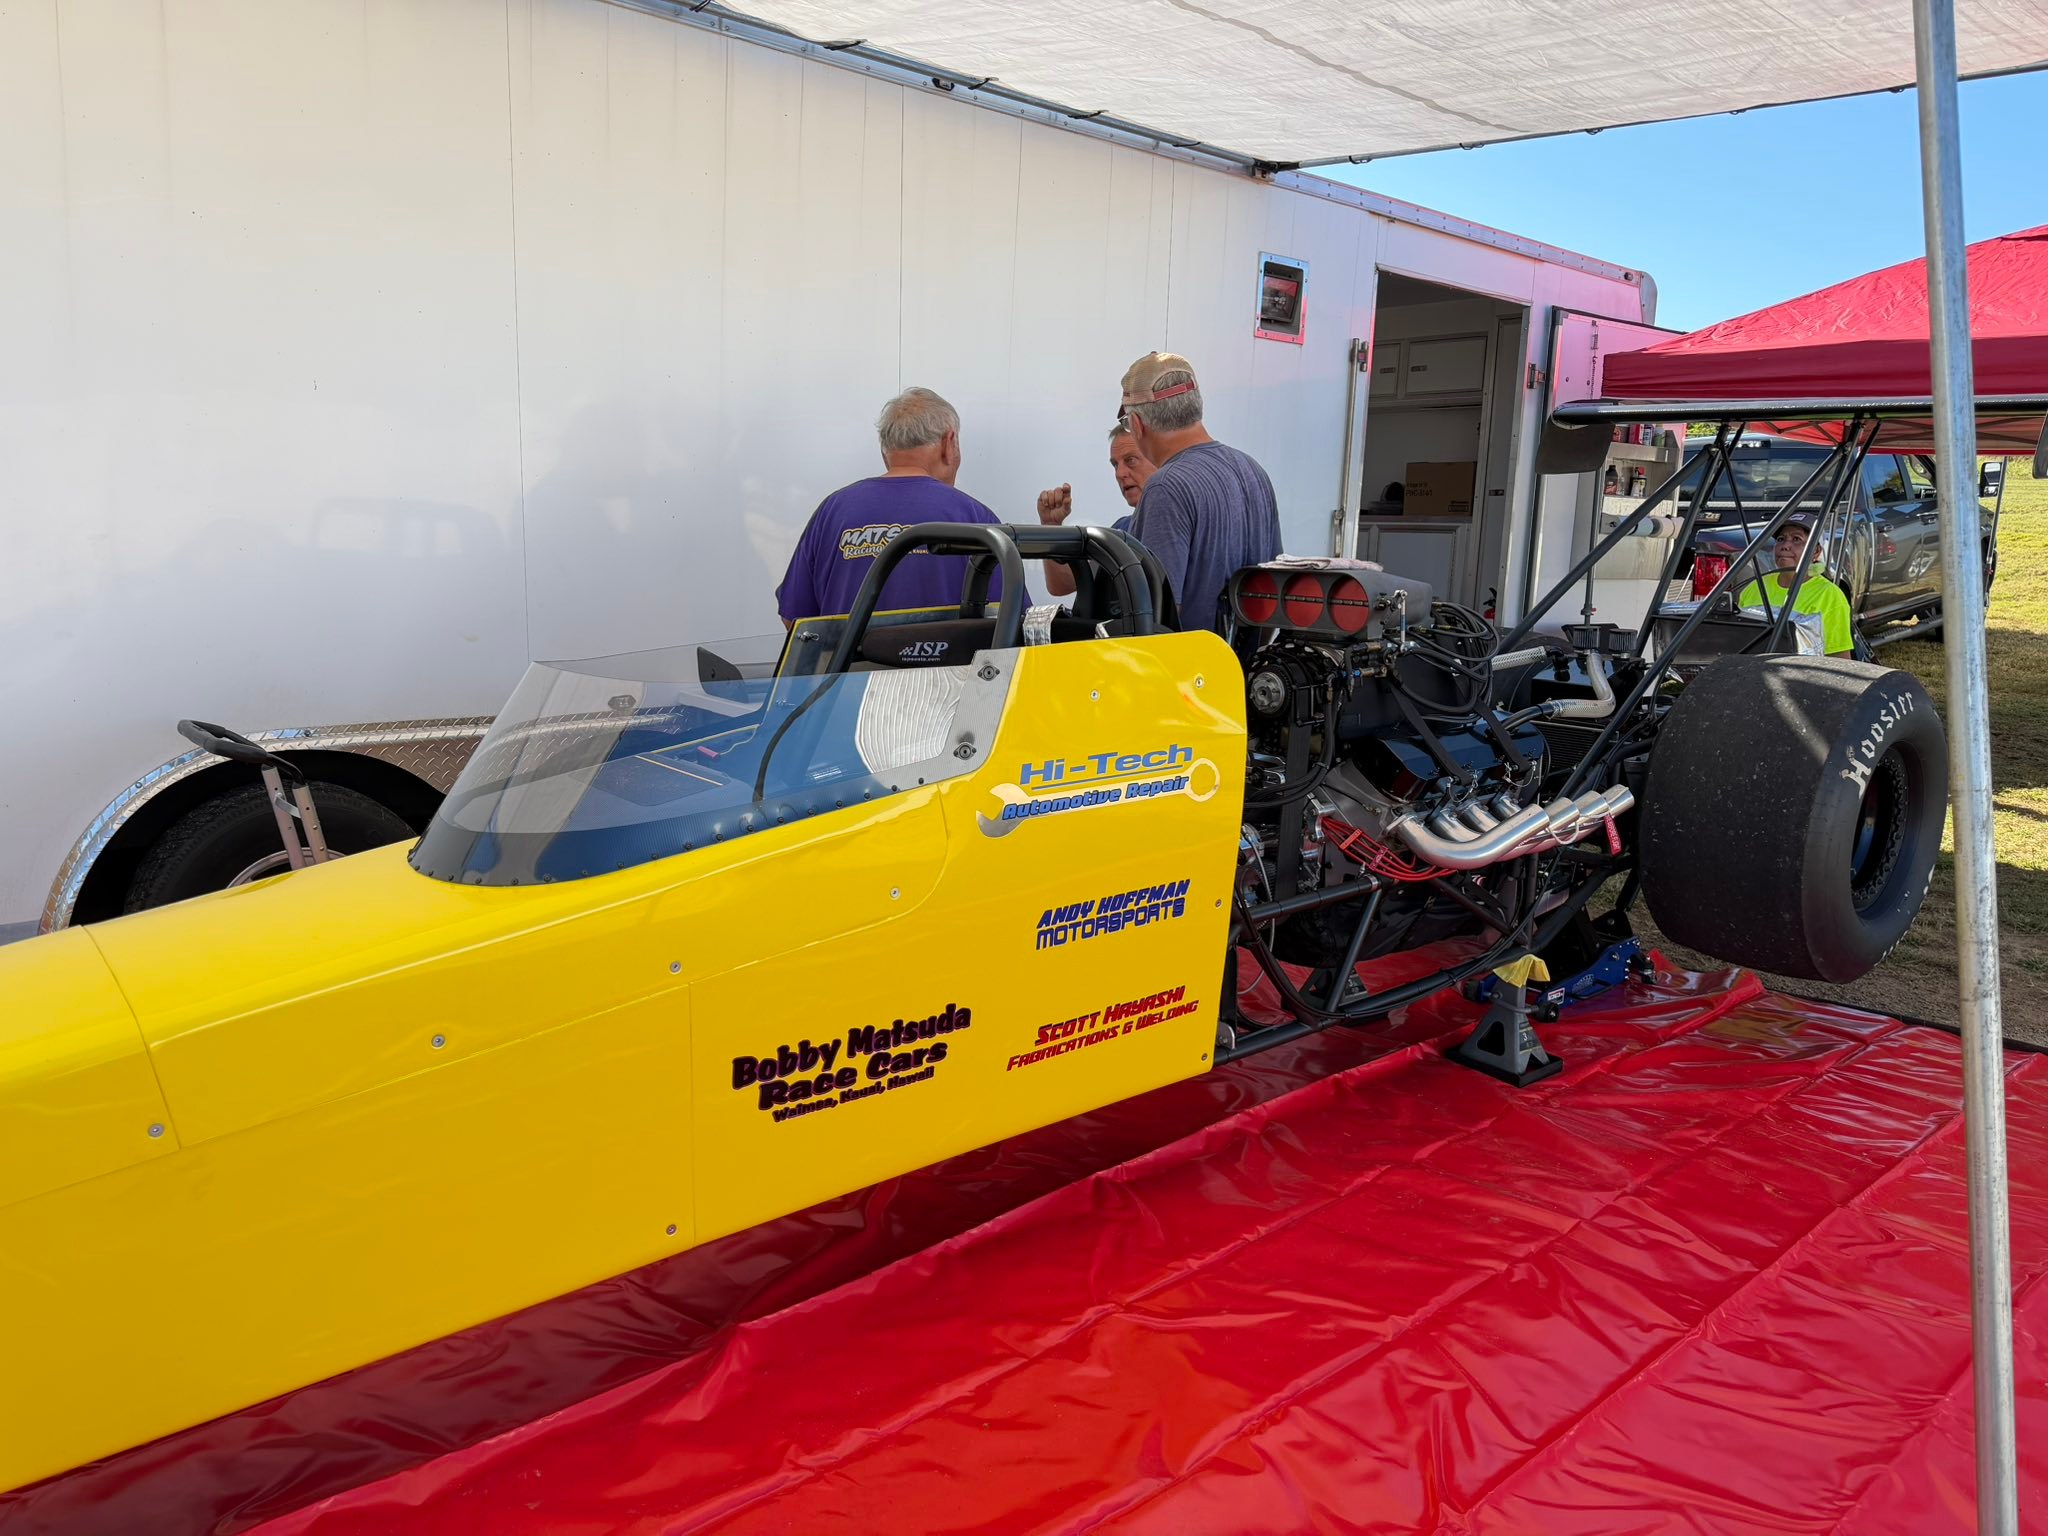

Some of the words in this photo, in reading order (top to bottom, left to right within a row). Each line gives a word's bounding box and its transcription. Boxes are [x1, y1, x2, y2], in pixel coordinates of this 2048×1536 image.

[841, 527, 901, 547] MATS
[912, 641, 949, 656] ISP
[1020, 743, 1193, 785] Hi-Tech
[1840, 691, 1914, 800] Hoosier
[1002, 789, 1121, 821] Automotive
[1125, 776, 1189, 798] Repair
[1036, 900, 1095, 929] ANDY
[1096, 879, 1190, 915] HOFFMAN
[1036, 897, 1186, 951] MOTORSPORTS
[732, 1039, 842, 1091] Bobby
[847, 1003, 972, 1059] Matsuda
[758, 1067, 858, 1111] Race
[866, 1042, 948, 1080] Cars
[772, 1098, 838, 1123] Waimea,
[839, 1081, 885, 1104] Kauai,
[886, 1065, 935, 1090] Hawaii
